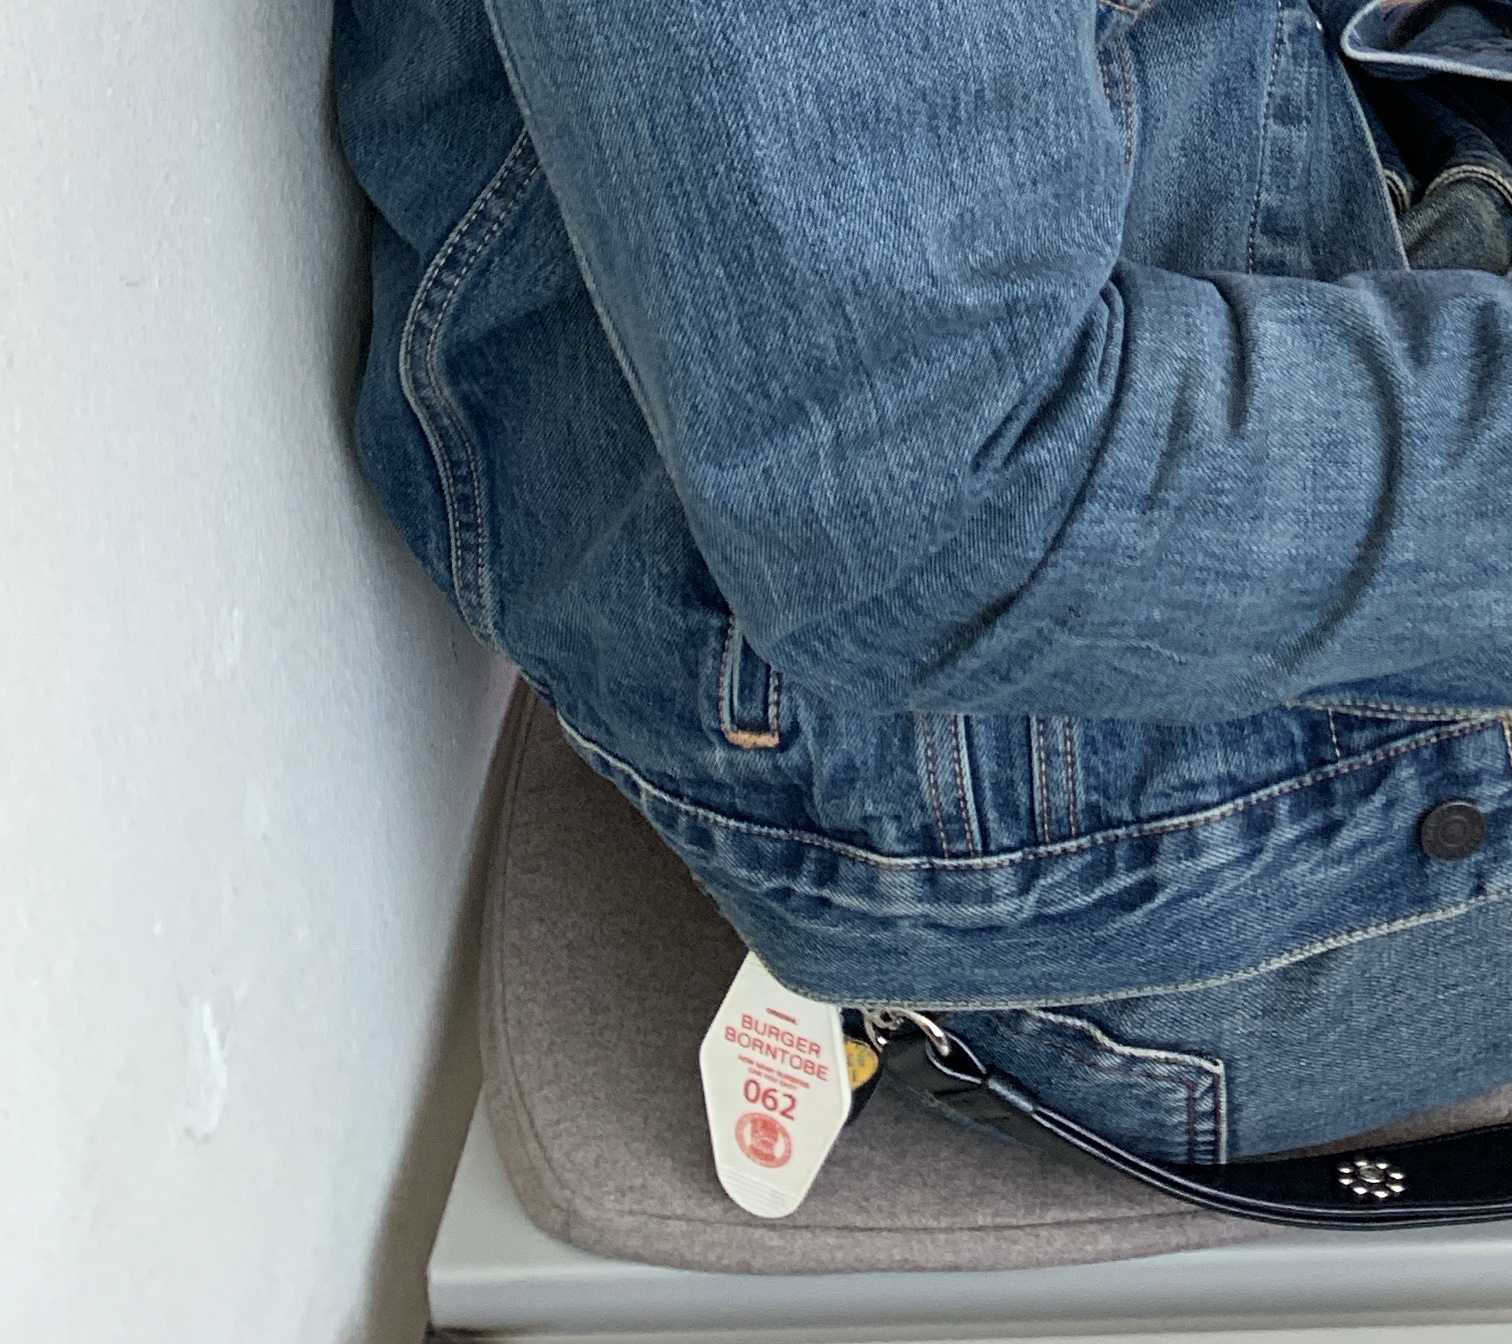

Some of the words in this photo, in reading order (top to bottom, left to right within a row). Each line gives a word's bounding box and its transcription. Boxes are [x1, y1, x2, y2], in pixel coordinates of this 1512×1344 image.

[724, 1026, 829, 1081] BORNTOBE
[741, 1014, 822, 1058] BURGER
[743, 1078, 797, 1121] 062
